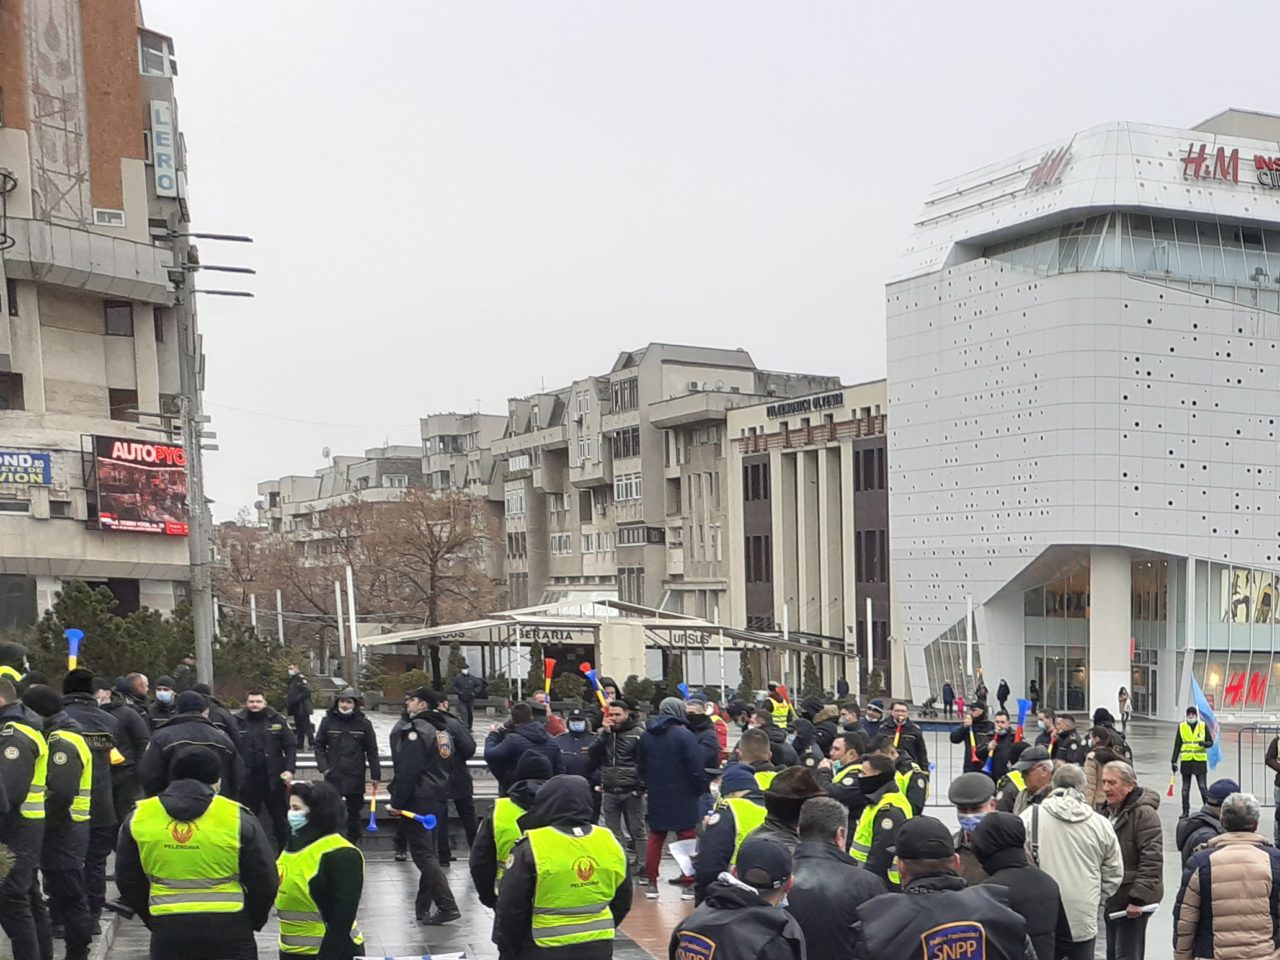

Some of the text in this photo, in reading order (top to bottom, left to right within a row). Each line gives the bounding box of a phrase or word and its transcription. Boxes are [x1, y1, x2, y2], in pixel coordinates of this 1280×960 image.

[154, 109, 175, 190] LERO
[1181, 142, 1240, 185] H&M
[1223, 671, 1267, 705] H&M
[933, 941, 977, 960] SNPP
